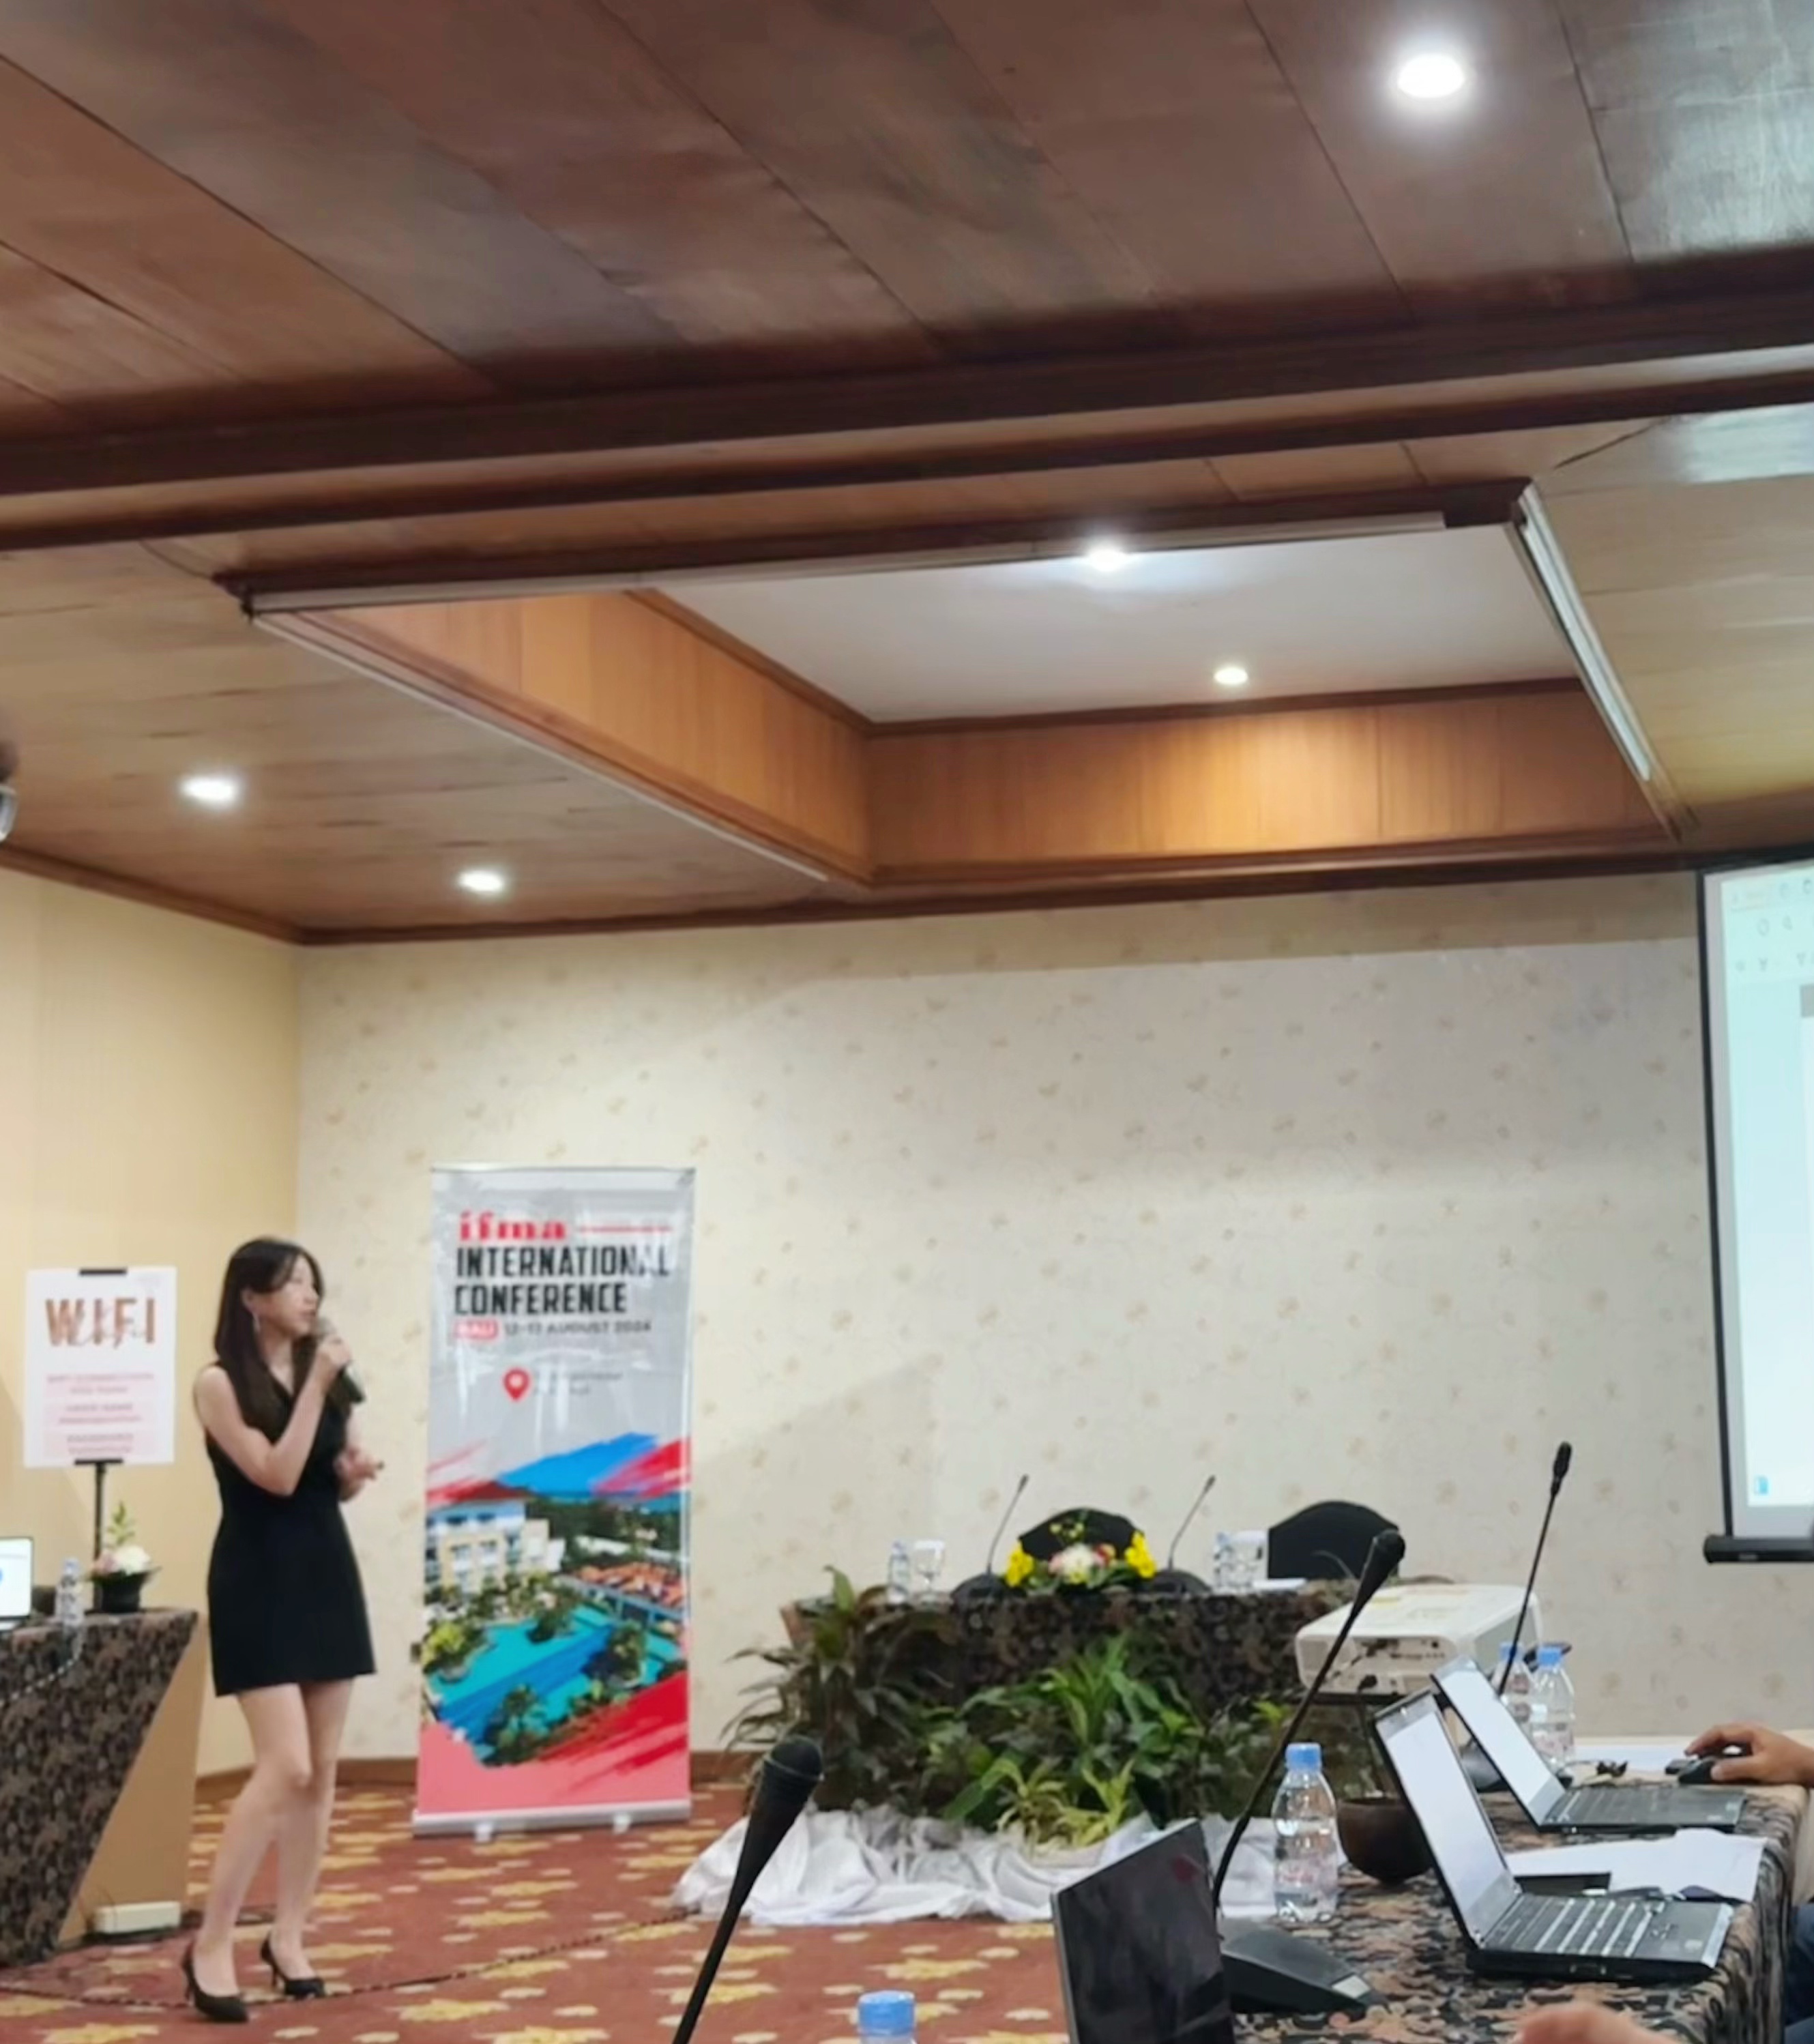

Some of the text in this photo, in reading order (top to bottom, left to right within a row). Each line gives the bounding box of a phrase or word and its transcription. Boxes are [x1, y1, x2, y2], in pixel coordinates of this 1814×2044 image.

[460, 1210, 566, 1240] ifma
[454, 1283, 627, 1315] CONFERENCE
[45, 1298, 156, 1345] WIFI
